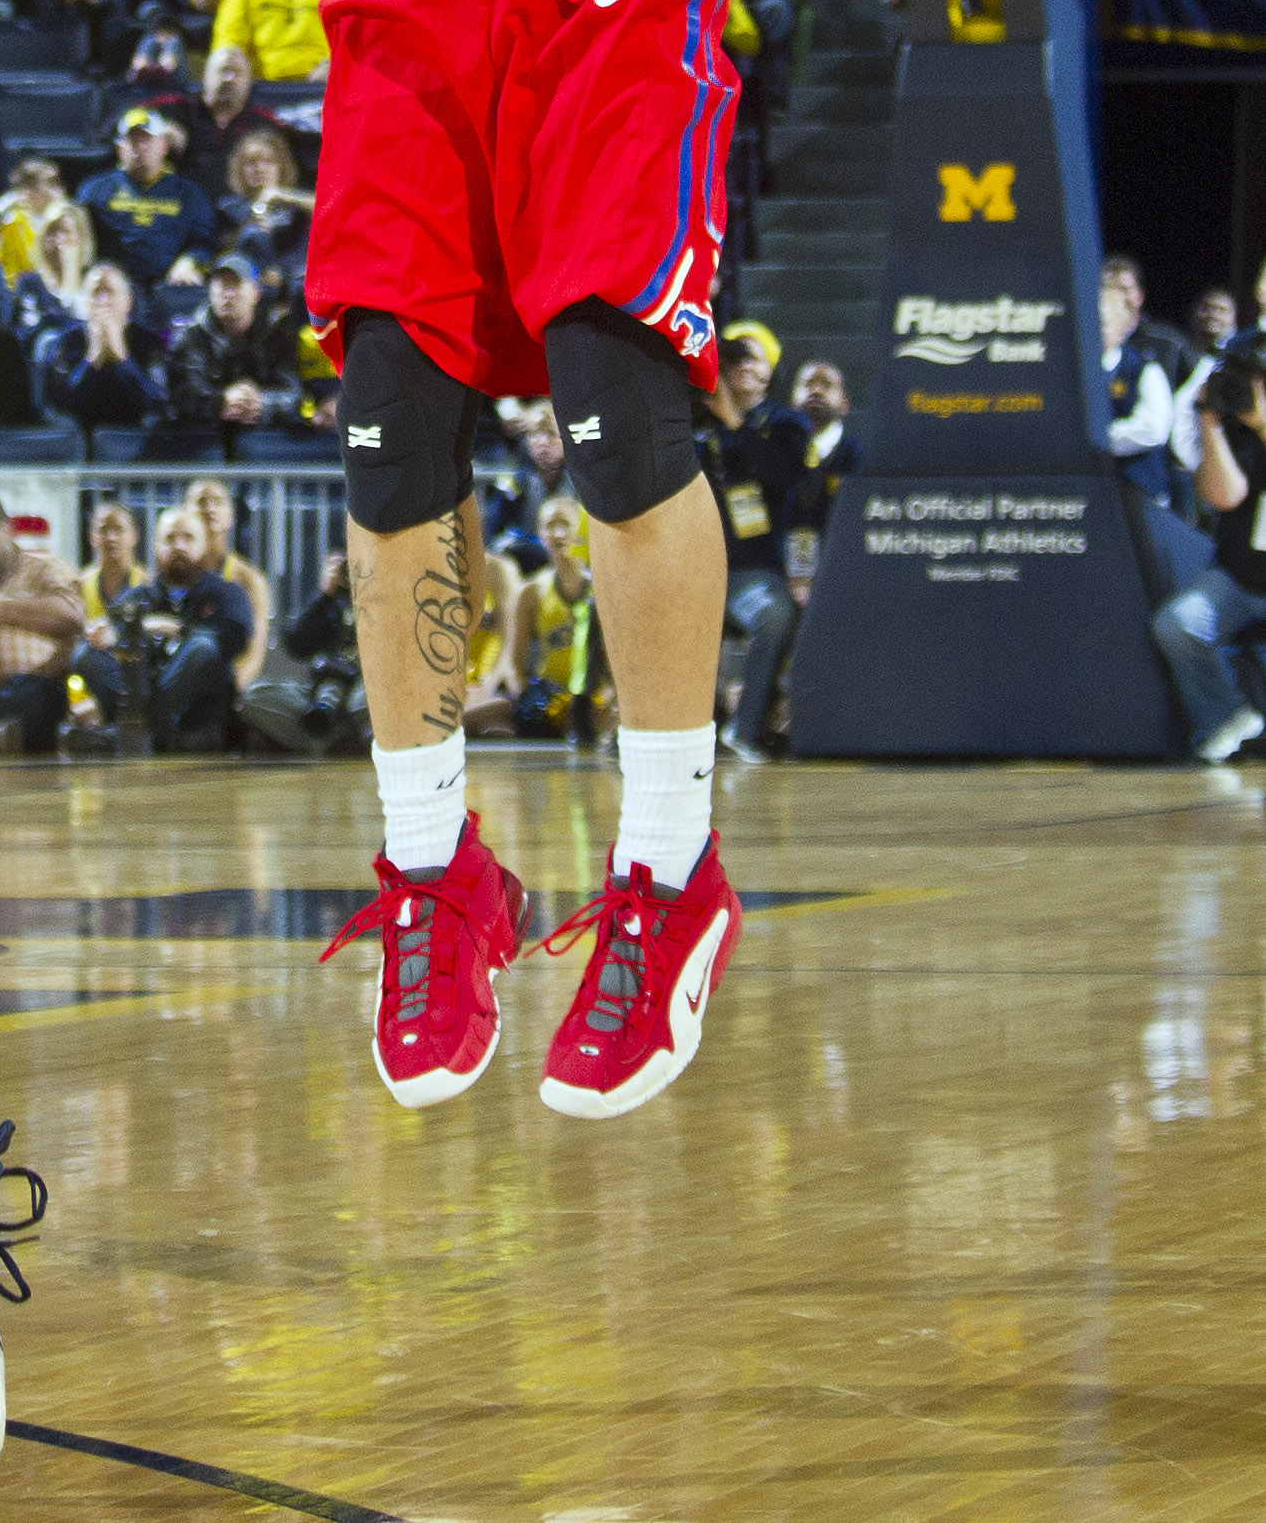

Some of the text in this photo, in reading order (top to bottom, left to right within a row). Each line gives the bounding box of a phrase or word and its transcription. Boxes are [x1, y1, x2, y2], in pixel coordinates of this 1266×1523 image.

[939, 163, 1016, 222] M
[894, 296, 1056, 341] Flagstar
[907, 390, 1043, 419] flagstar.com
[865, 494, 1087, 520] An Official Partner
[865, 530, 1087, 559] Michigan Athletics
